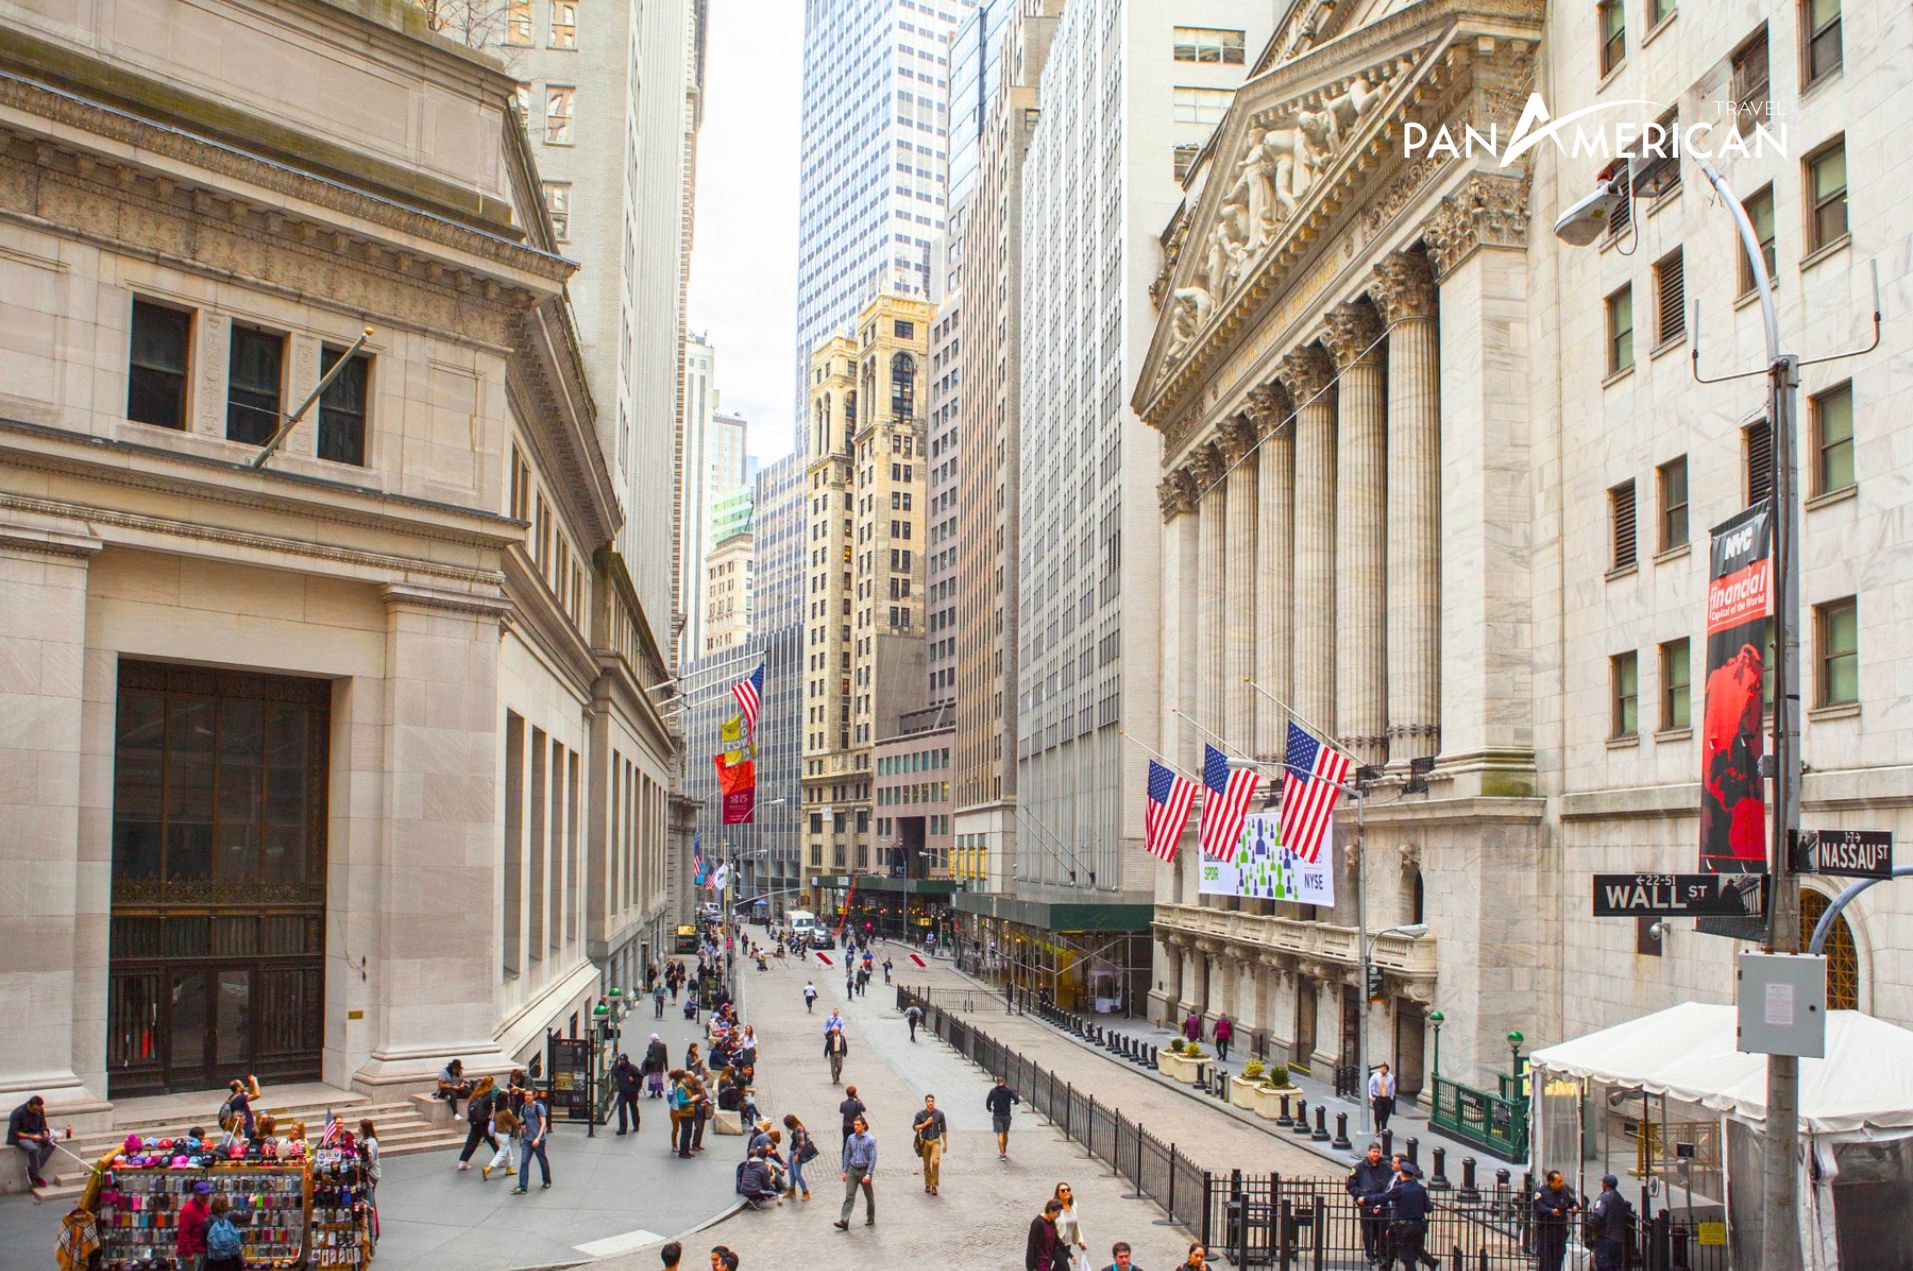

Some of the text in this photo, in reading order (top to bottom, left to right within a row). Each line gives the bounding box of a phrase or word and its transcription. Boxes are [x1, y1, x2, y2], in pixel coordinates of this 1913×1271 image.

[1724, 527, 1753, 560] NYC
[1709, 565, 1766, 619] financial
[1821, 842, 1889, 870] NASSAU ST
[1304, 873, 1323, 890] NYSE
[1645, 875, 1676, 886] 22-51
[1605, 885, 1708, 909] WALL ST
